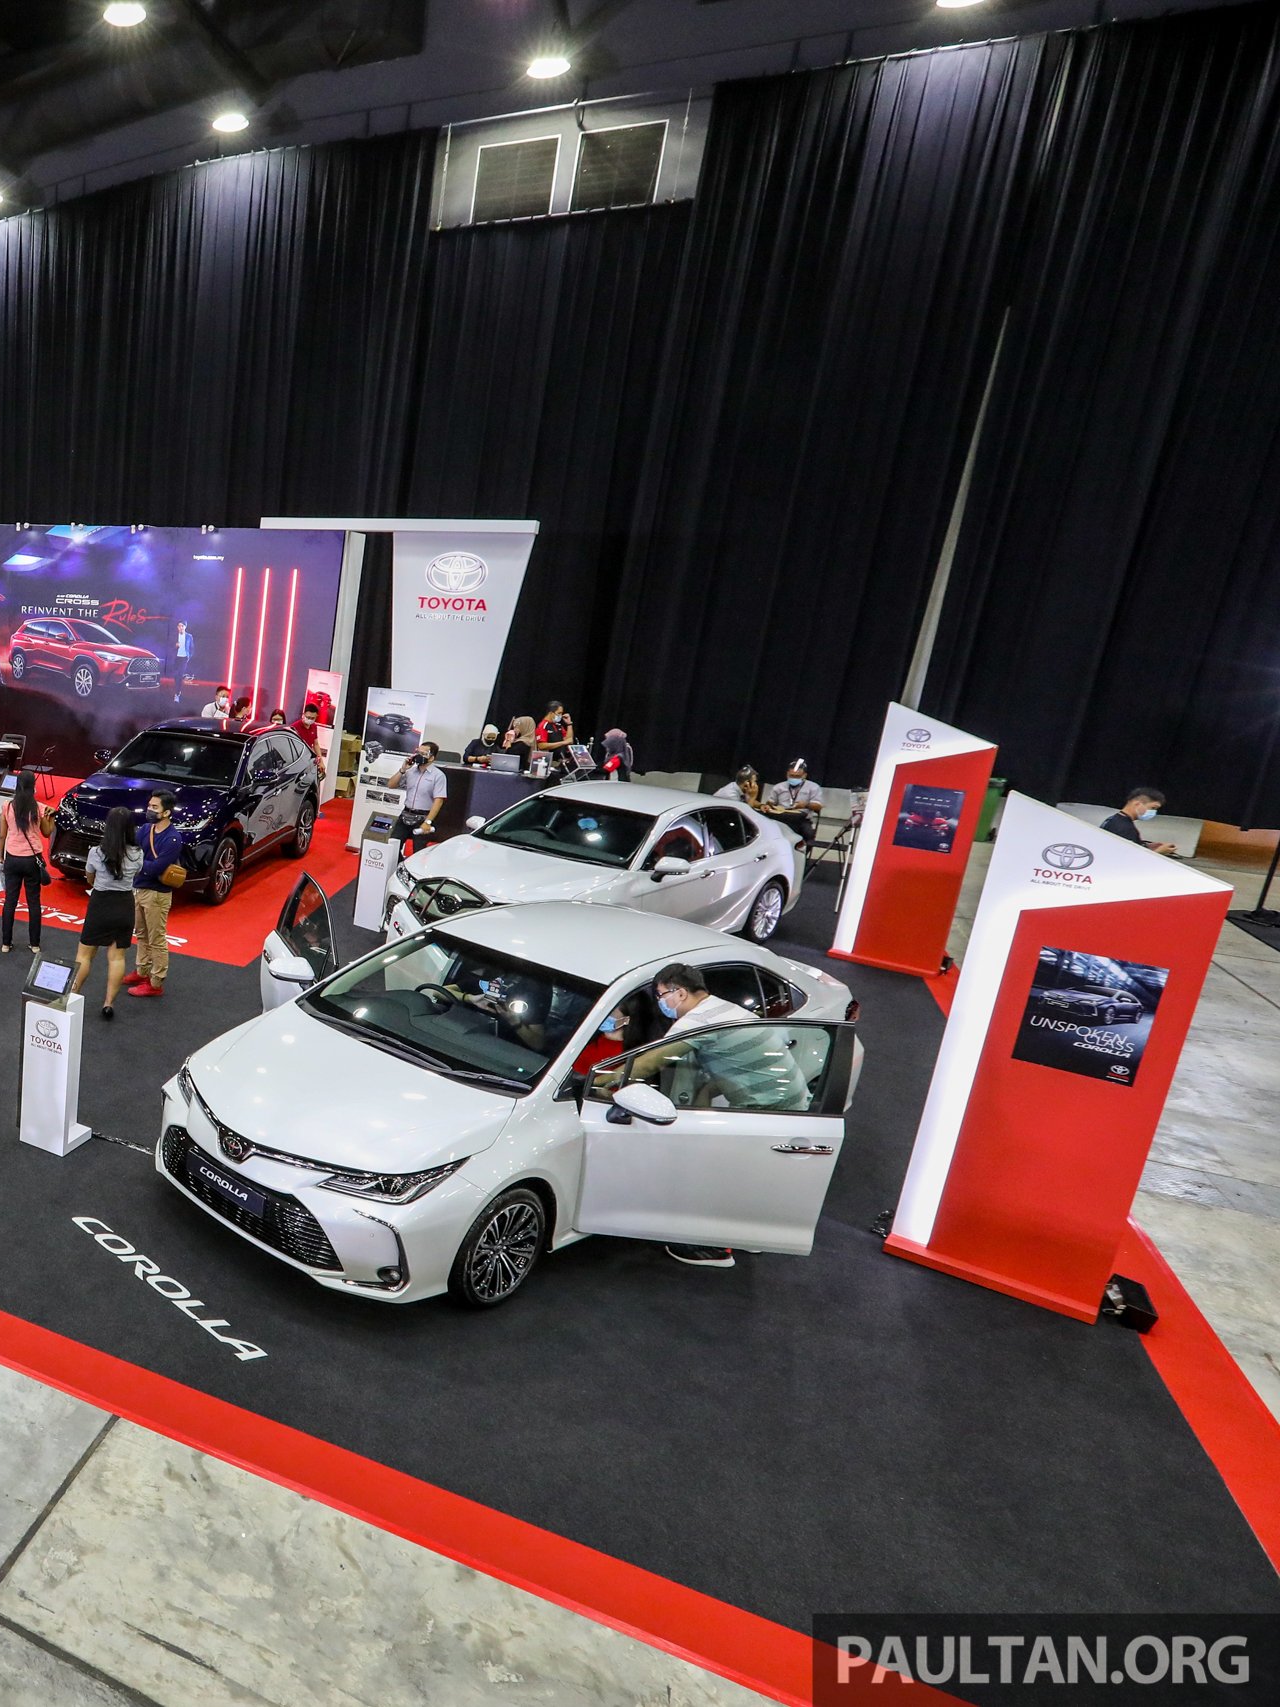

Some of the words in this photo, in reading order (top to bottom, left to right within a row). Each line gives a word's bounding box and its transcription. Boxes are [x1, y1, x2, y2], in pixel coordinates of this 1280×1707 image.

[55, 598, 100, 606] CROSS
[418, 596, 487, 611] TOYOTA
[21, 605, 73, 616] REINVENT
[78, 608, 99, 618] THE
[100, 597, 168, 633] Rules
[901, 742, 931, 750] TOYOTA
[365, 859, 385, 868] TOYOTA
[1033, 868, 1093, 884] TOYOTA
[1030, 1015, 1127, 1044] UNSPOKEN
[30, 1034, 63, 1051] TOYOTA
[1073, 1041, 1131, 1059] COROLLA
[1084, 1033, 1135, 1053] CLASS
[199, 1166, 249, 1202] COROLLA
[71, 1216, 269, 1362] COROLLA
